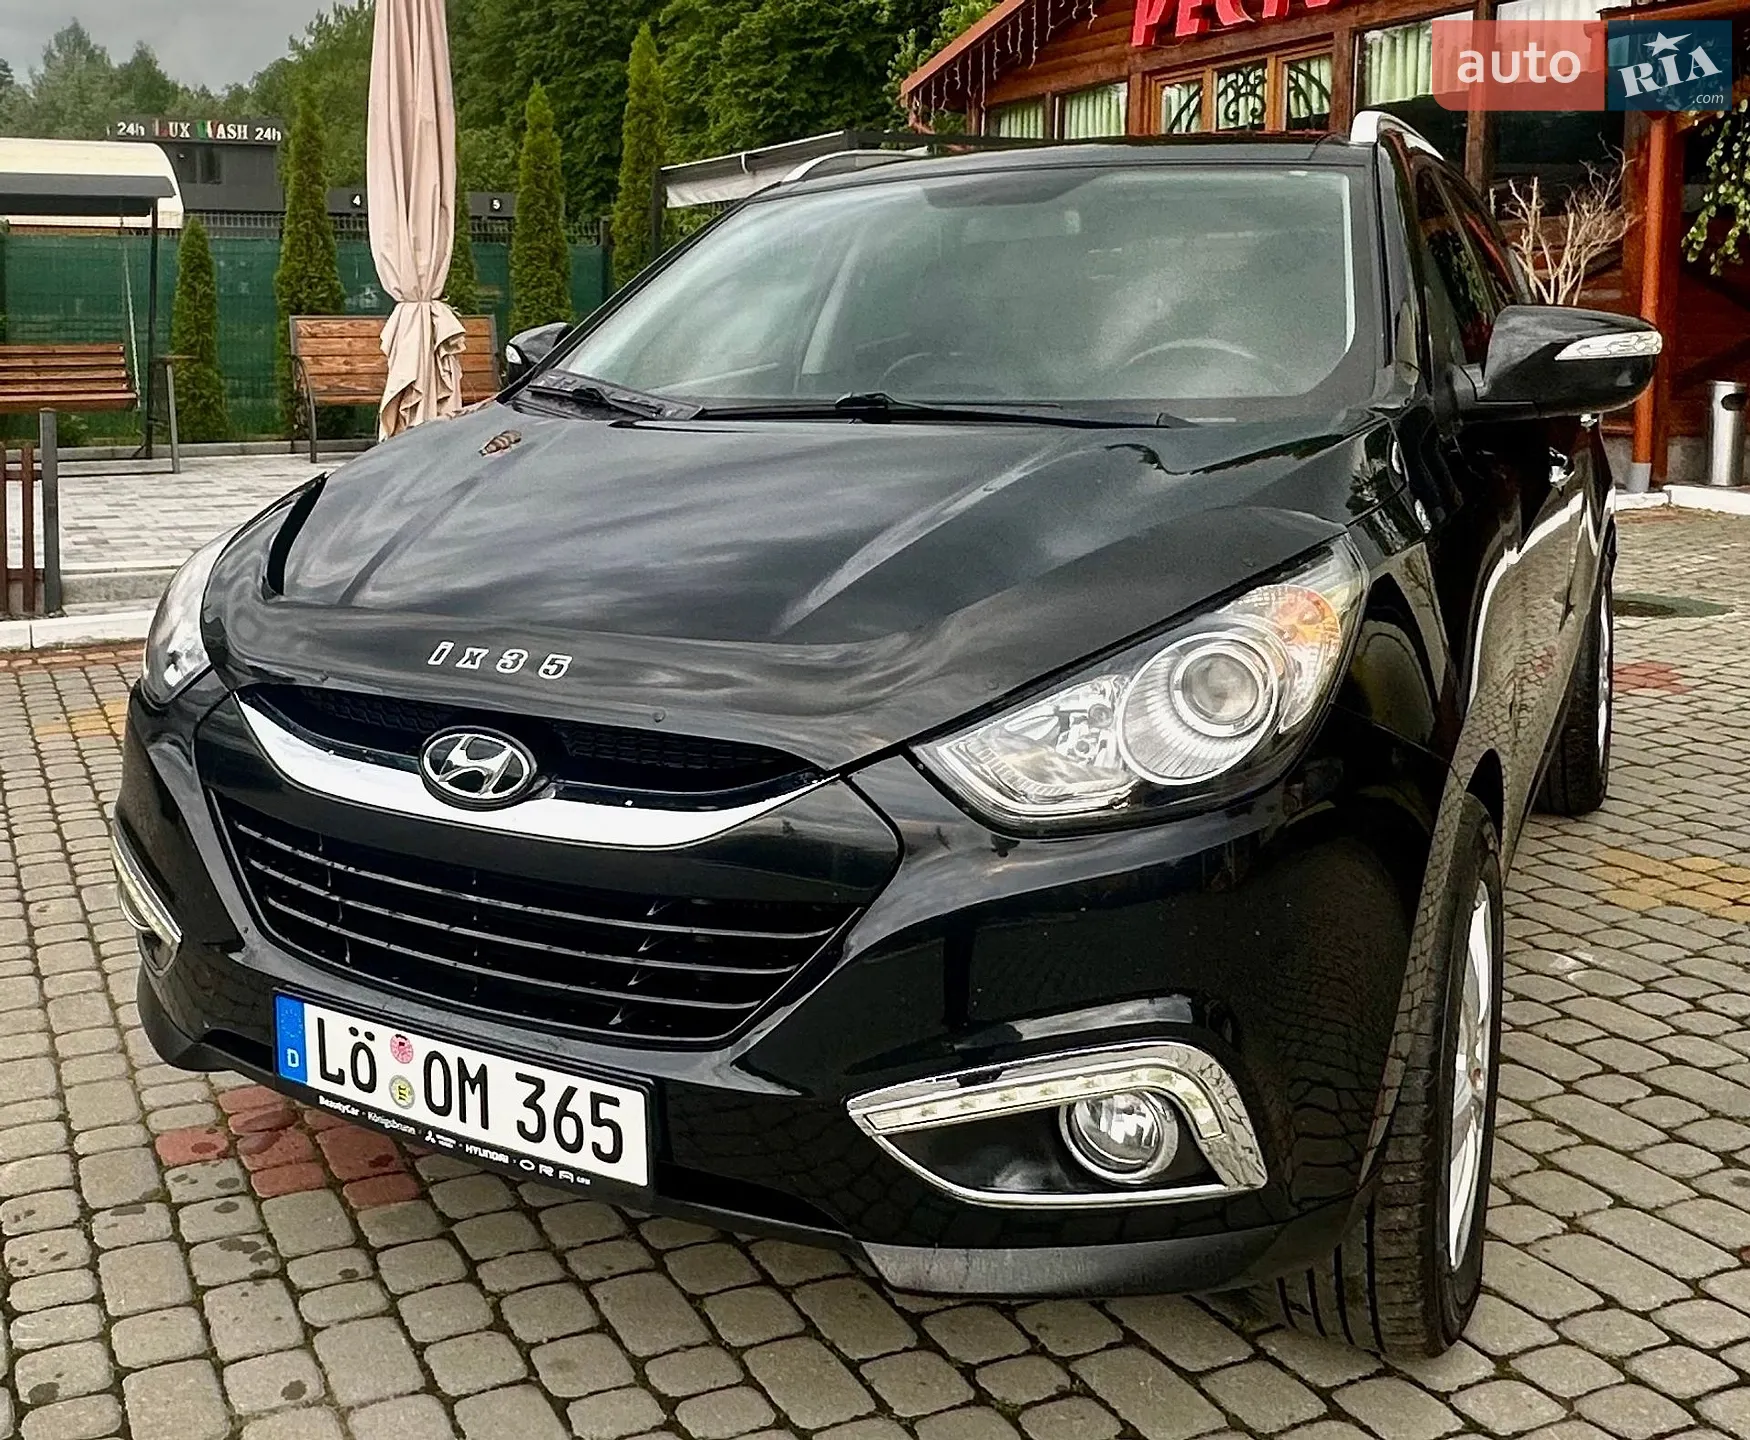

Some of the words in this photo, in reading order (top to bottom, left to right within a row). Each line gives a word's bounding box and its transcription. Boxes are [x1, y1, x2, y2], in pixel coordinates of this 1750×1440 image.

[117, 121, 145, 136] 24h
[254, 127, 282, 142] 24h
[352, 194, 361, 206] 4
[492, 199, 501, 210] 5
[286, 1048, 300, 1069] D
[317, 1017, 377, 1094] LÖ
[422, 1050, 490, 1131] OM
[515, 1071, 624, 1164] 365
